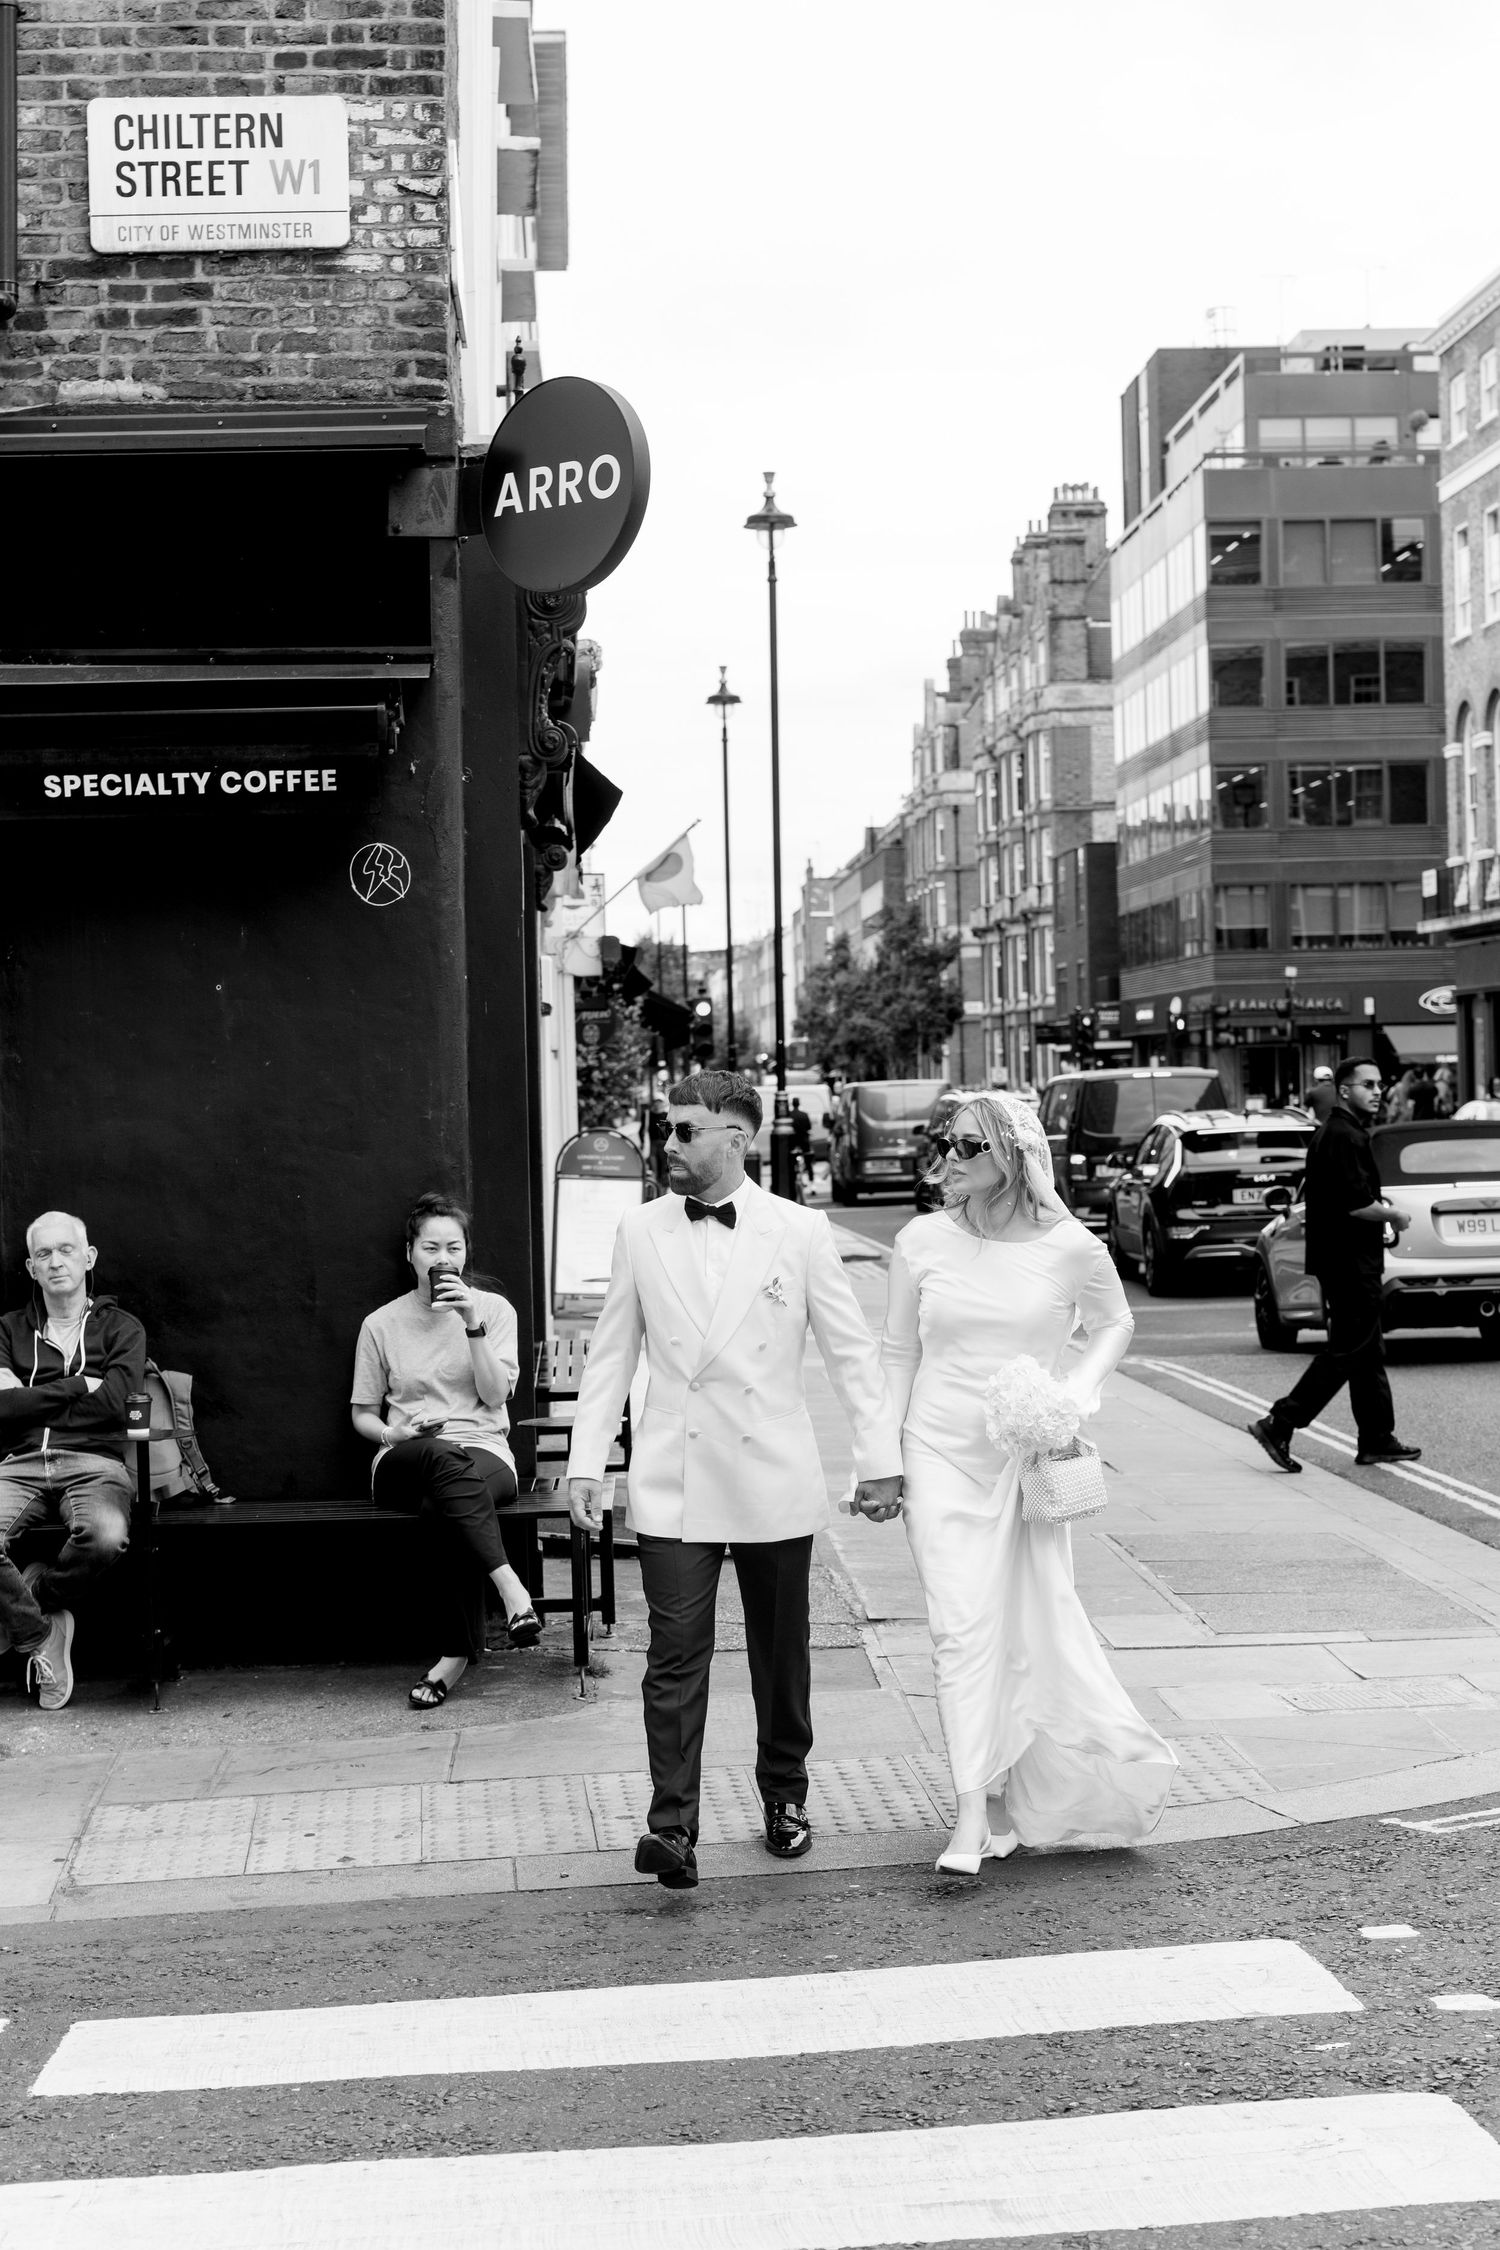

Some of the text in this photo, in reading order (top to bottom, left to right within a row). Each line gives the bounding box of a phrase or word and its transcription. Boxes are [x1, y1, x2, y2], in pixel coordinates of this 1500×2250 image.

[114, 113, 283, 151] CHILTERN
[115, 159, 321, 198] STREET W1
[117, 222, 313, 242] CITY OF WESTMINSTER
[493, 453, 621, 518] ARRO
[43, 769, 337, 798] SPECIALTY COFFEE
[1240, 1190, 1263, 1201] EN7
[1456, 1218, 1487, 1233] W99
